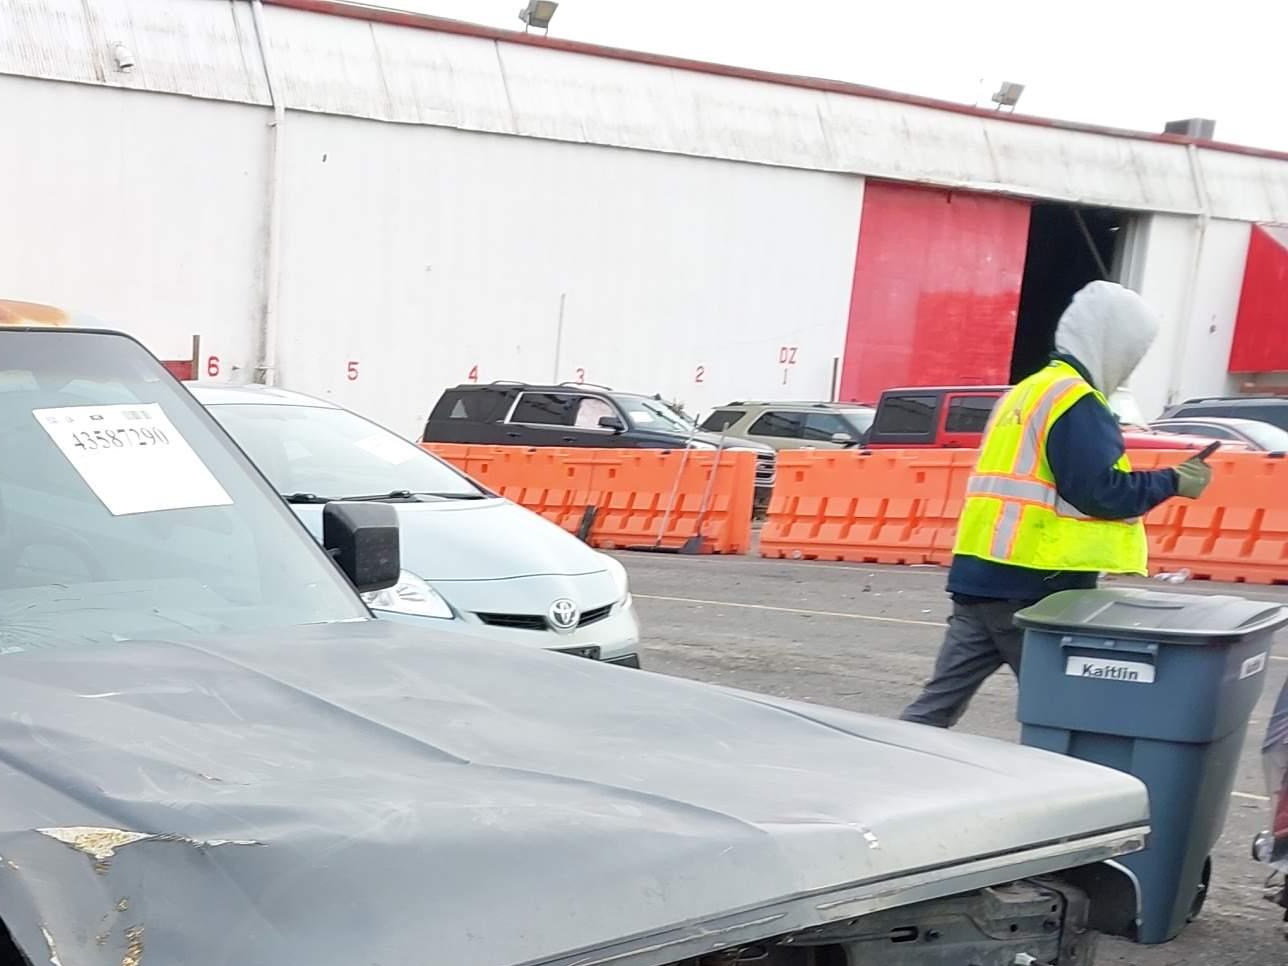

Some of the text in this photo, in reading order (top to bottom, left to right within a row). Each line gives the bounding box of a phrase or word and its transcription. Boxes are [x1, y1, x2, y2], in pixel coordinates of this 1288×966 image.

[206, 355, 220, 377] 6
[347, 361, 359, 381] 5
[468, 365, 479, 383] 4
[695, 366, 705, 383] 2
[576, 368, 586, 385] 3
[71, 425, 171, 451] 43587290
[1082, 663, 1139, 681] Kaitlin
